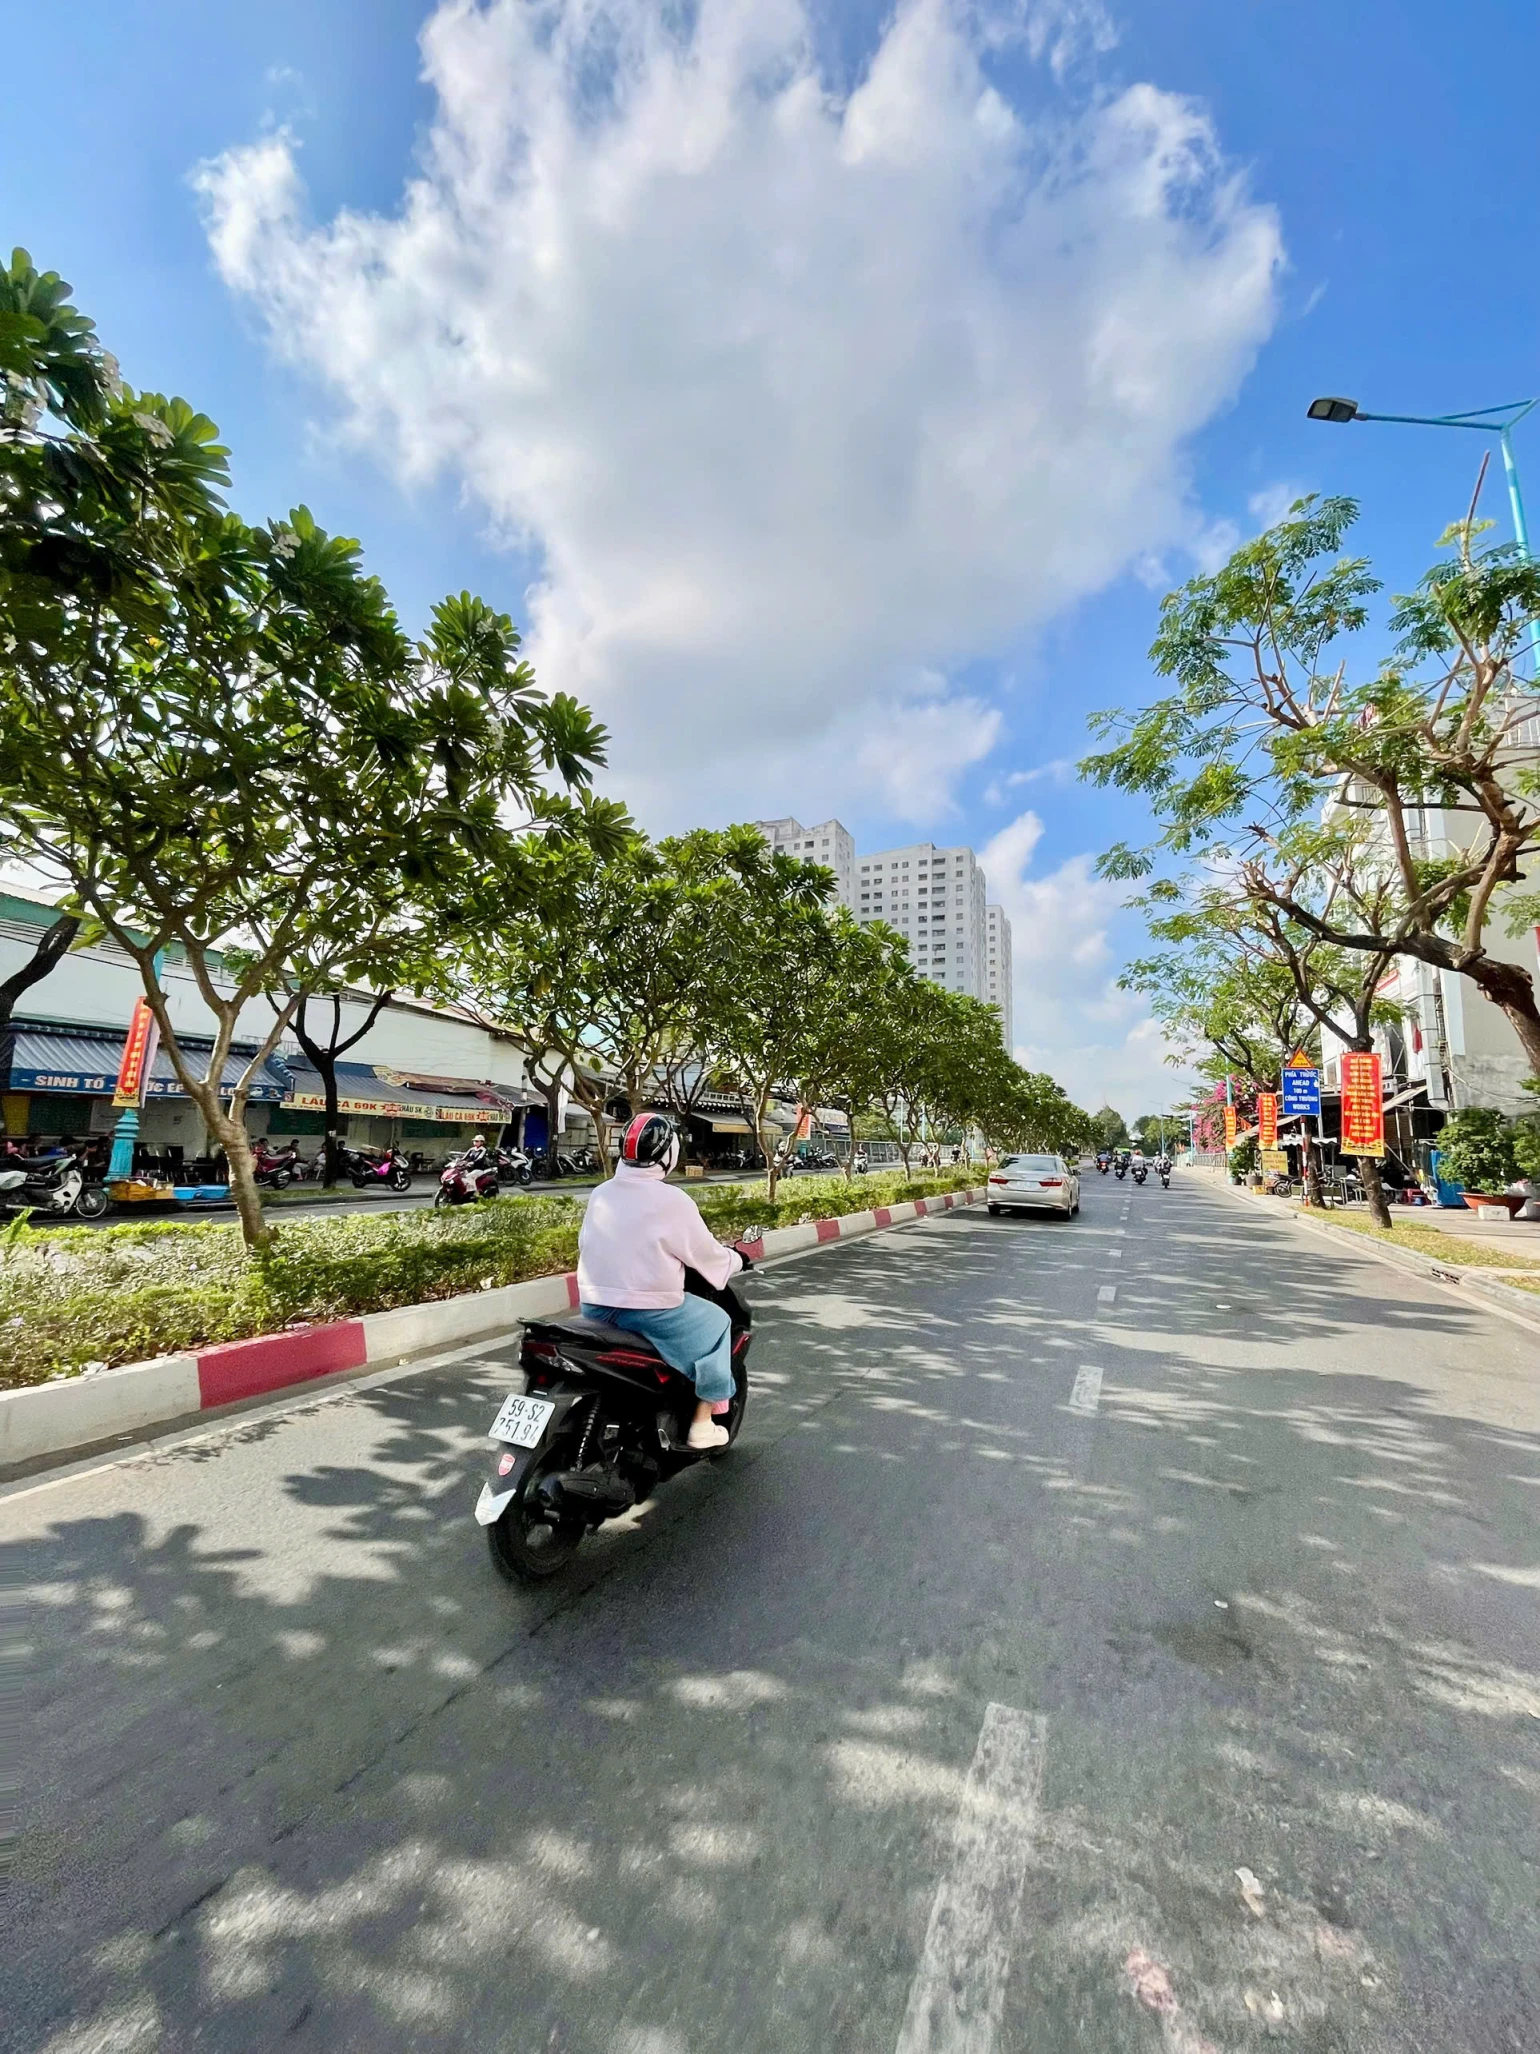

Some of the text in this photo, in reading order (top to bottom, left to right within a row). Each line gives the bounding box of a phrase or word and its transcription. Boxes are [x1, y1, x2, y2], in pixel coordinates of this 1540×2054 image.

[34, 1075, 79, 1088] SINH
[84, 1075, 106, 1089] TỐ
[354, 1102, 377, 1111] 69K
